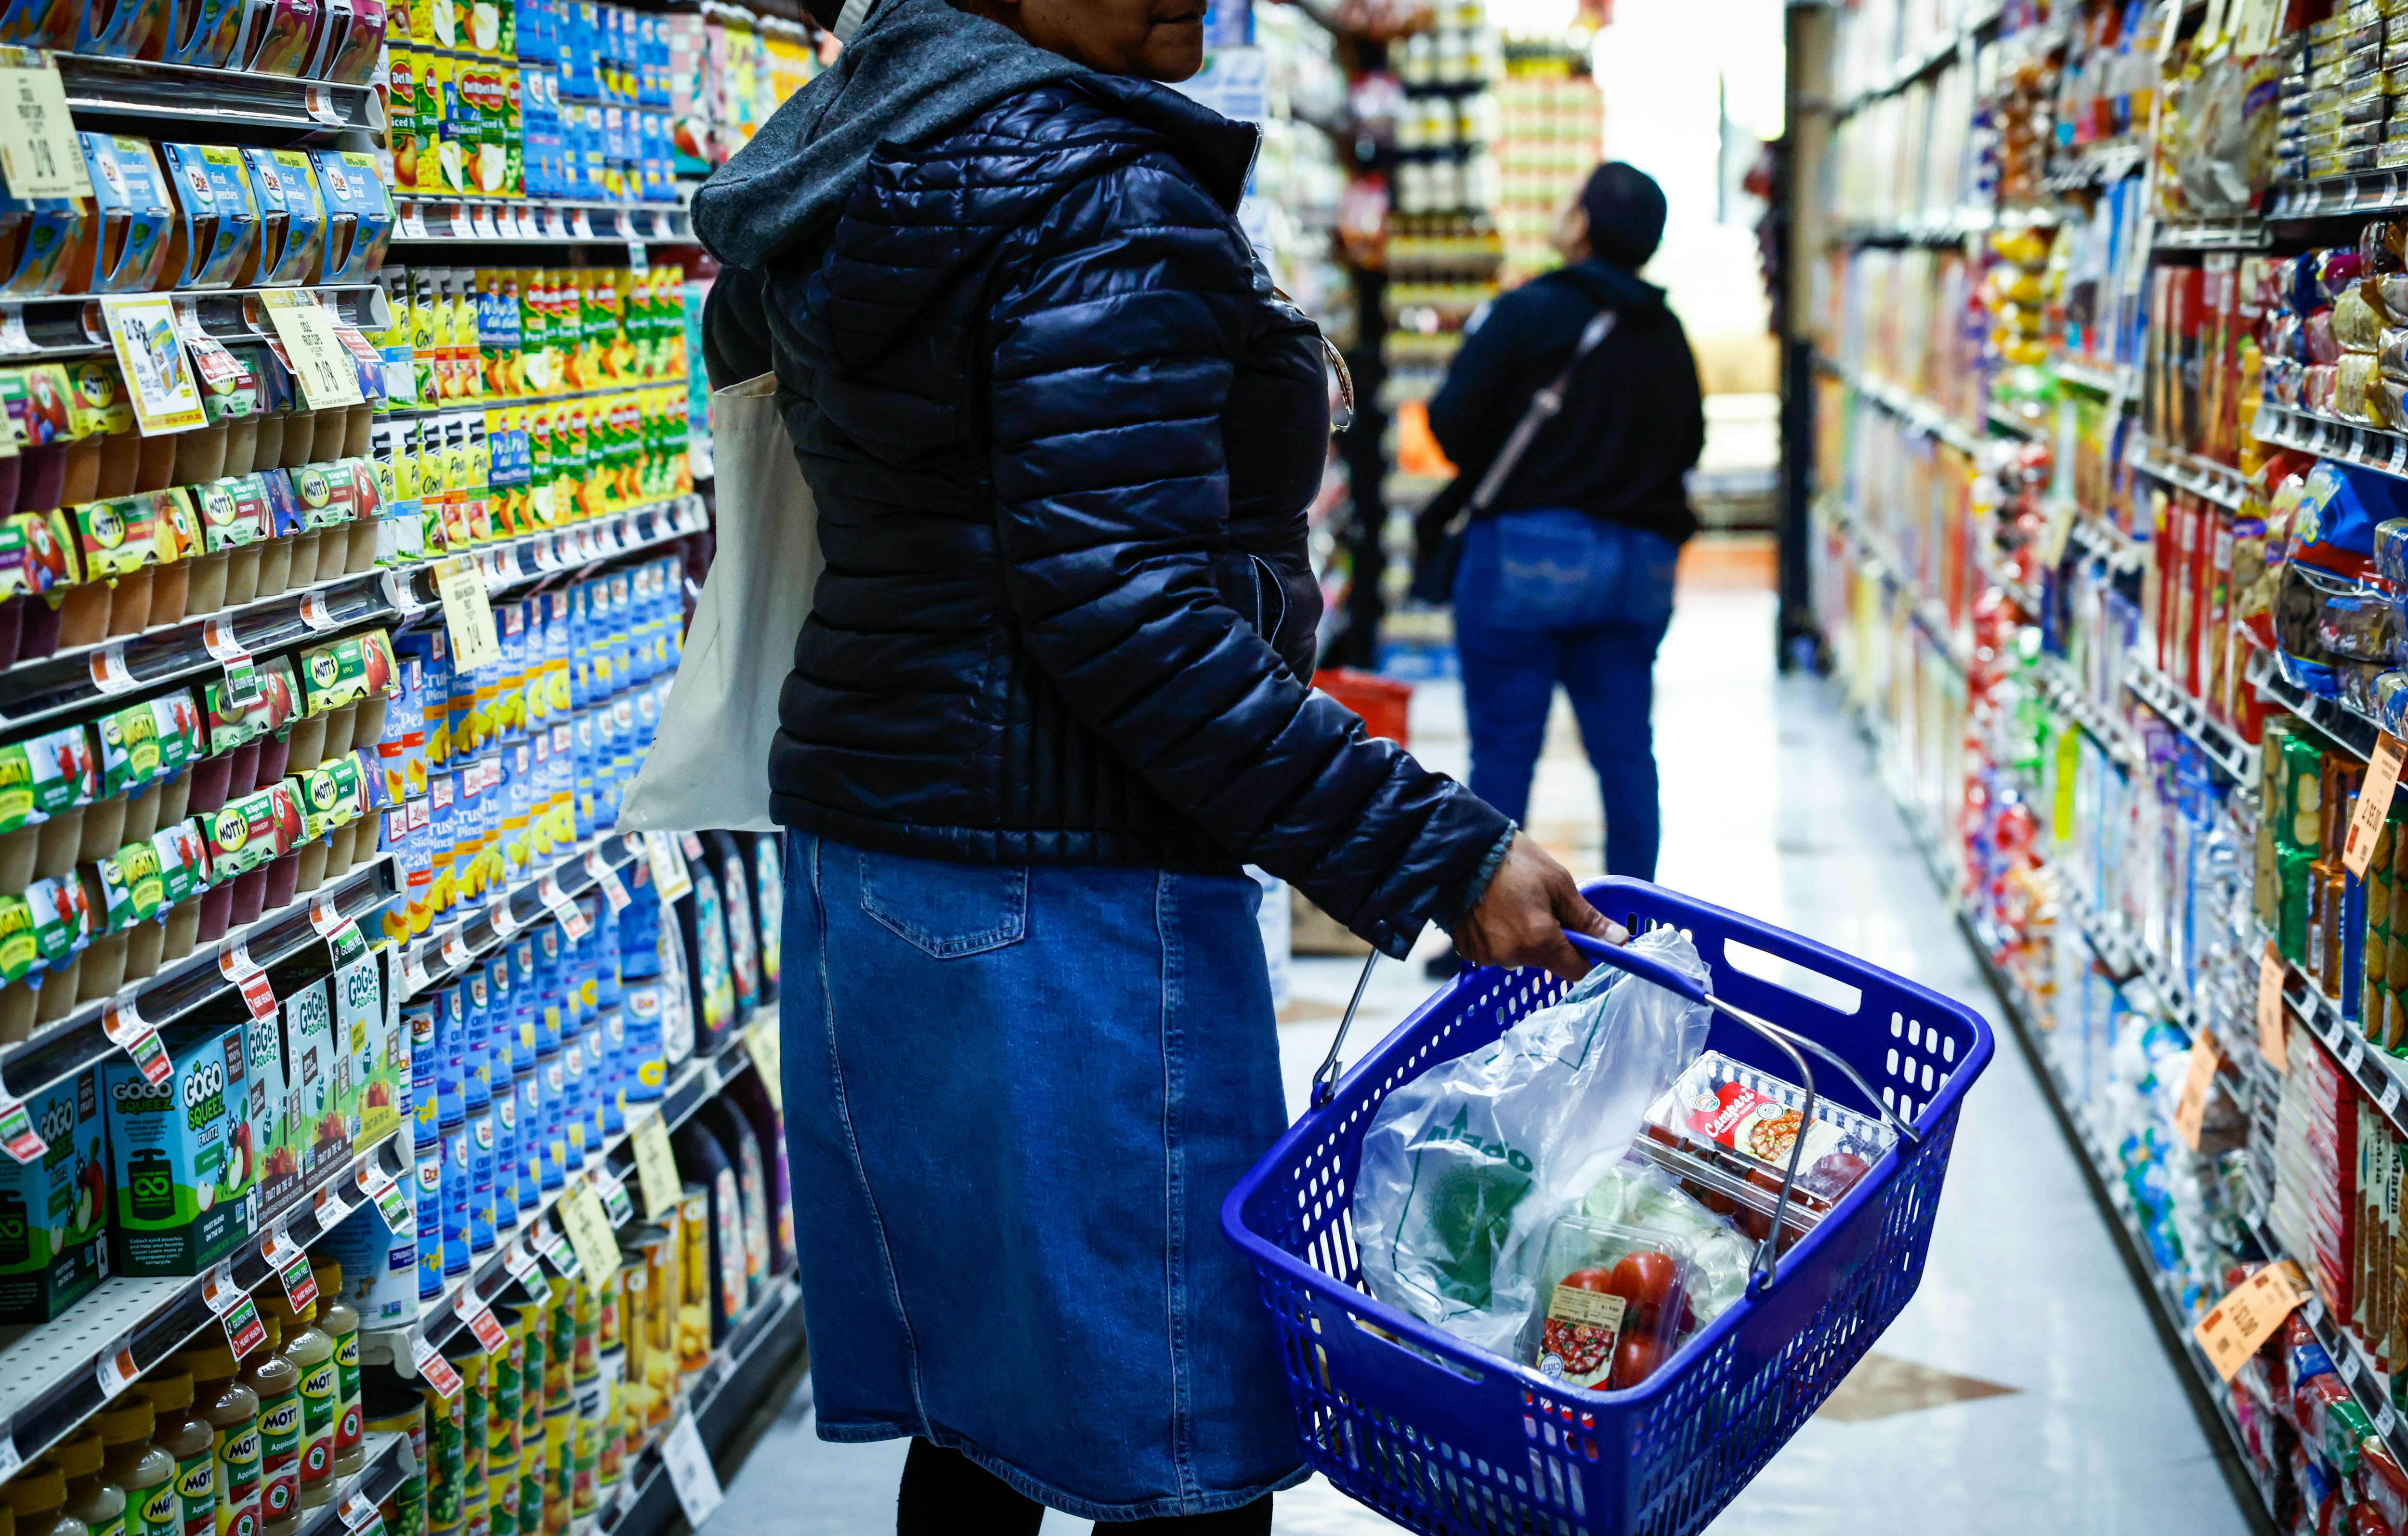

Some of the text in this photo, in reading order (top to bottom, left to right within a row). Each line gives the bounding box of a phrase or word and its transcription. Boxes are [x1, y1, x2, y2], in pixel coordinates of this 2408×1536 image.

[303, 480, 328, 498] MOTT'S
[209, 495, 234, 514] MOTT'S
[314, 658, 336, 680] MOTT'S
[314, 780, 335, 801] MOTT'S
[219, 818, 246, 842] MOTT'S
[341, 935, 363, 956] GLUTEN FREE
[228, 1050, 241, 1063] 100%
[229, 1061, 242, 1076] FRUIT
[183, 1061, 223, 1108] GOGO
[116, 1098, 175, 1113] SQUEEZ
[188, 1094, 224, 1130] SQUEEZ
[1701, 1095, 1718, 1111] SUNSET
[1764, 1105, 1780, 1119] CHEF
[1704, 1088, 1755, 1138] Campari
[1719, 1101, 1756, 1134] TOMATOES TOMATES
[198, 1124, 219, 1147] FRUITZ
[249, 1205, 255, 1222] 4
[203, 1221, 214, 1233] FRUIT
[206, 1233, 212, 1242] ON
[289, 1266, 309, 1284] GLUTEN FREE
[296, 1283, 316, 1302] HEART HEALTH
[232, 1307, 254, 1329] GLUTEN FREE
[240, 1326, 262, 1347] HEART HEALTH
